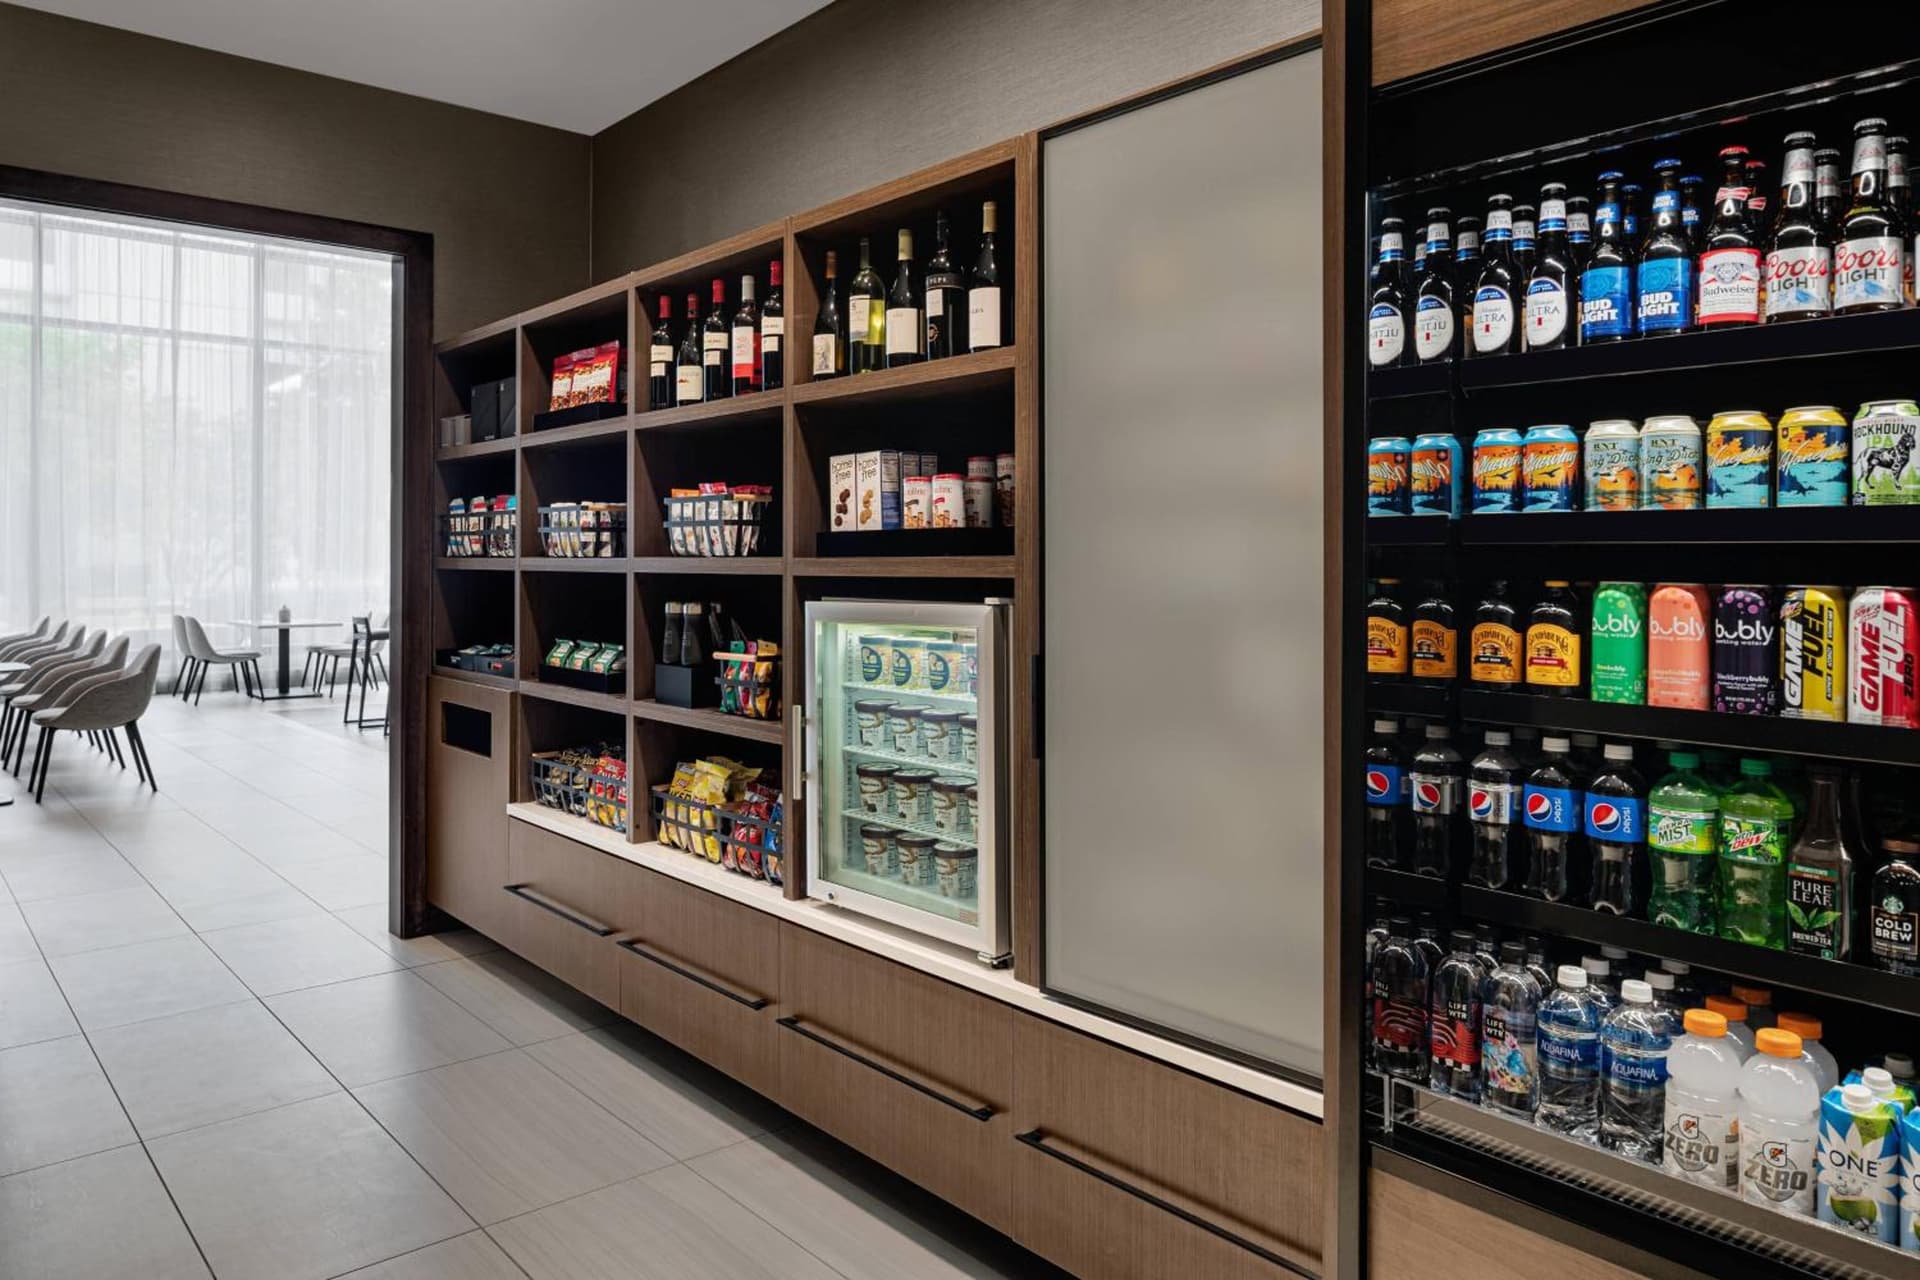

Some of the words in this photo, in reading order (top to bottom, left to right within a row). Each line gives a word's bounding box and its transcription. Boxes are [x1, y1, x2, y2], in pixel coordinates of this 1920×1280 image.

[1766, 253, 1829, 281] Coors
[1834, 244, 1900, 274] Coors
[1771, 277, 1818, 293] LIGHT
[1839, 268, 1887, 286] LIGHT
[1641, 291, 1673, 305] BUD
[1703, 285, 1756, 297] Budweiser
[1584, 299, 1612, 313] BUD
[1638, 302, 1680, 319] LIGHT
[1715, 618, 1775, 646] bubly
[1802, 604, 1825, 678] FUEL
[1883, 605, 1906, 683] FUEL
[1784, 618, 1803, 706] GAME
[1861, 622, 1880, 712] GAME
[1904, 653, 1915, 700] ZERO
[1554, 797, 1562, 824] pepsi
[1622, 807, 1632, 834] pepsi
[1658, 823, 1692, 844] MIST
[1793, 880, 1833, 896] PURE
[1875, 917, 1912, 932] COLD
[1875, 927, 1912, 942] BREW
[1611, 1061, 1659, 1081] AQUAFINA
[1665, 1130, 1719, 1165] ZERO
[1744, 1159, 1809, 1191] ZERO
[1829, 1150, 1878, 1178] ONE
